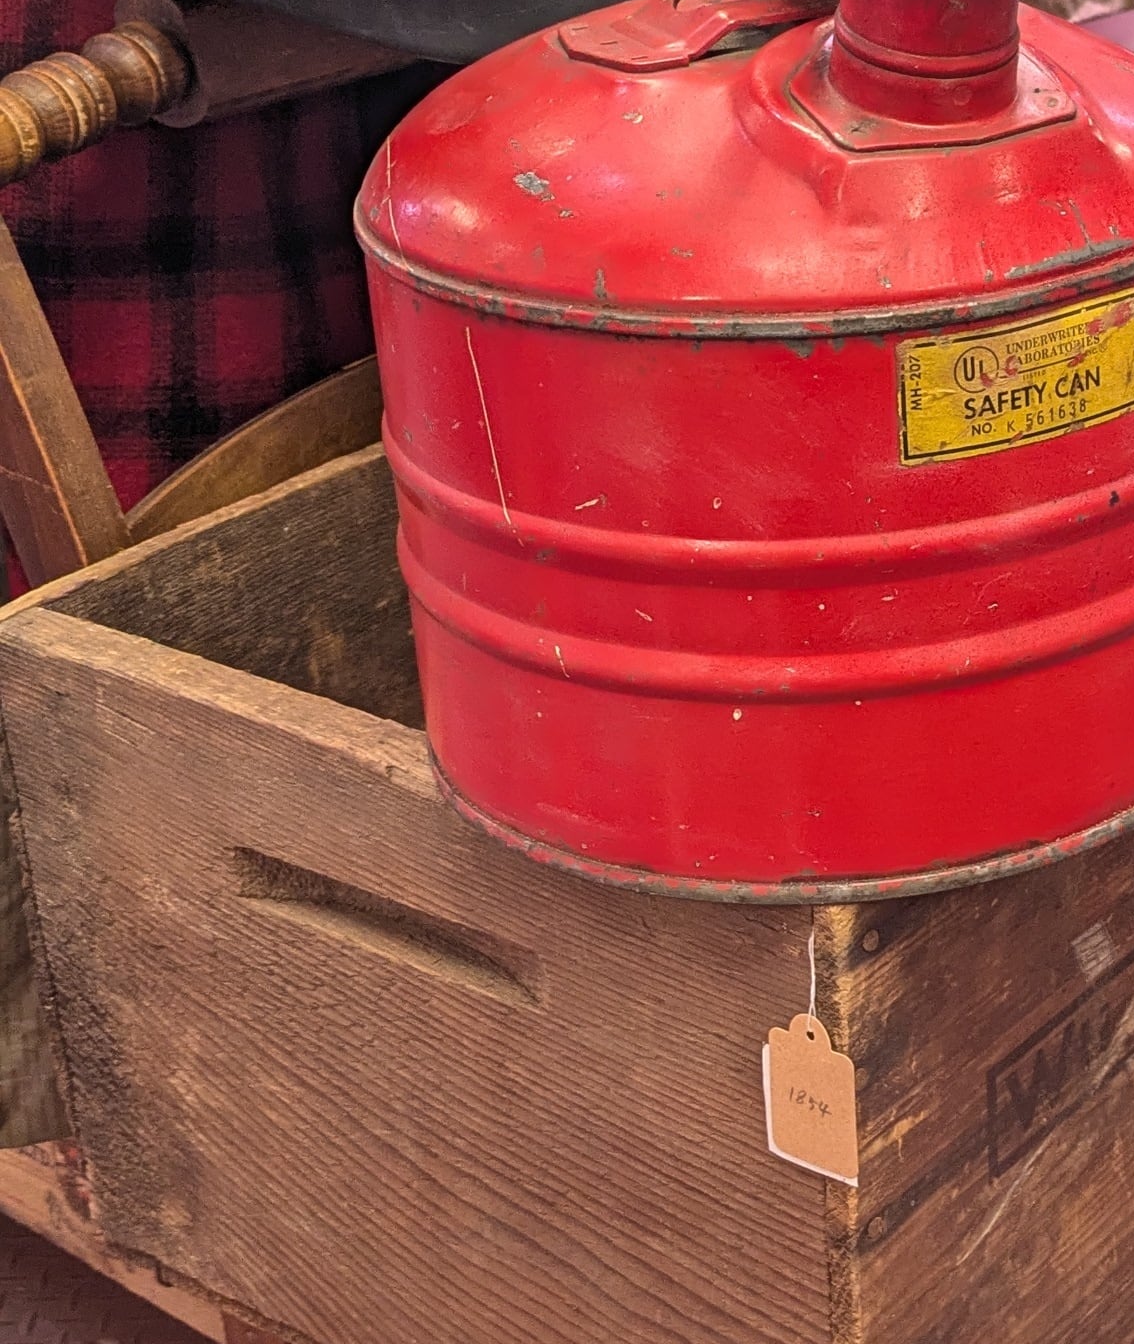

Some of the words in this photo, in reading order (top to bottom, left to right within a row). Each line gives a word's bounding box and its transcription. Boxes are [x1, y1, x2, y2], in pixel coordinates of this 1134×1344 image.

[1005, 322, 1096, 355] UNDERWRITE
[909, 356, 923, 411] MH-207
[963, 381, 1048, 420] SAFETY
[1055, 366, 1101, 399] CAN
[971, 421, 997, 437] NO.
[1007, 420, 1016, 433] K
[1025, 398, 1088, 427] 561638
[789, 1086, 832, 1118] 1854
